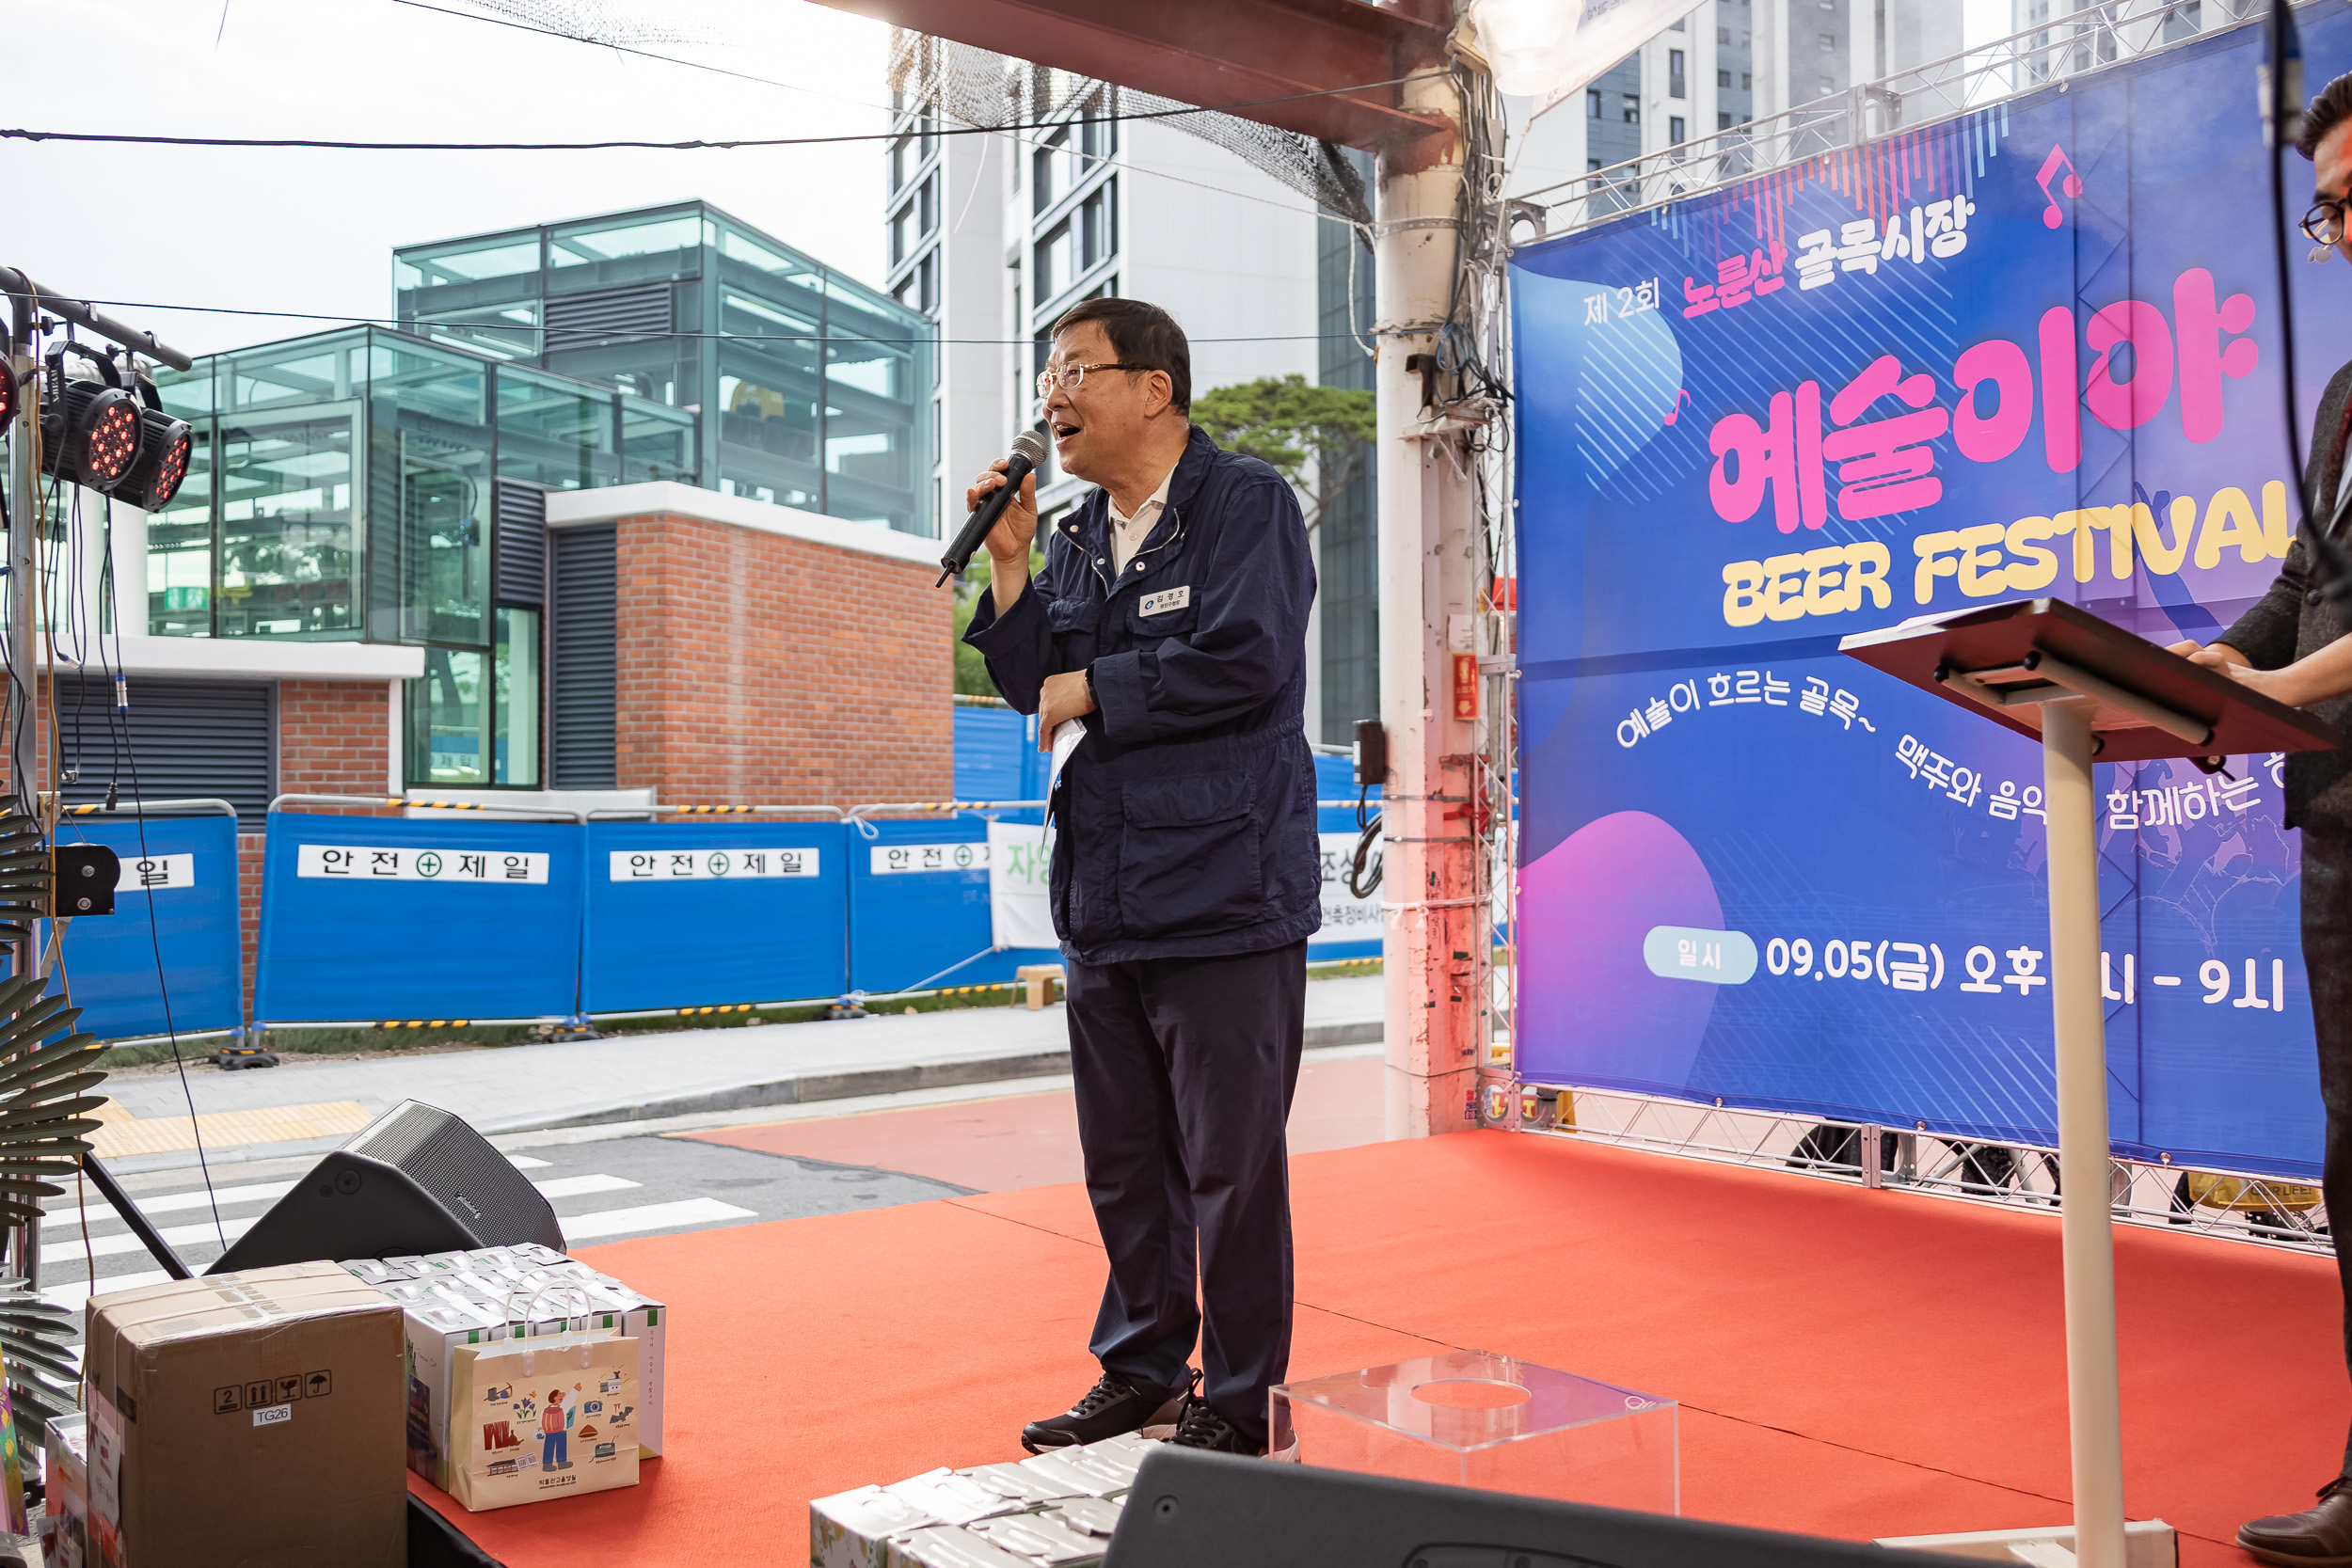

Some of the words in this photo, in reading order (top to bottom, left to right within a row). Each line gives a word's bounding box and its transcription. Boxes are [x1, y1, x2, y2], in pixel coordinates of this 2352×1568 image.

[1683, 240, 1788, 320] 노룬산
[1794, 193, 1976, 292] 골목시장
[1583, 293, 1608, 326] 제
[1616, 277, 1661, 320] 2회
[1708, 267, 2260, 535] 예술이야
[1722, 541, 1893, 628] BEER
[1914, 480, 2298, 606] FESTIVAL
[1616, 678, 1701, 749] 예술이
[1708, 670, 1791, 706] 흐르는
[1799, 675, 1877, 734] 골목~
[1895, 734, 1982, 808] 맥주와
[2106, 774, 2262, 831] 함께하는
[322, 849, 399, 876] 안전
[458, 854, 530, 879] 제일
[630, 854, 694, 877] 안전
[743, 851, 803, 874] 제일
[1677, 939, 1721, 971] 일시
[1766, 937, 1945, 992] 09.05(금)
[1960, 944, 2047, 996] 오후
[2199, 958, 2284, 1012] 9시
[257, 1407, 288, 1422] TG26
